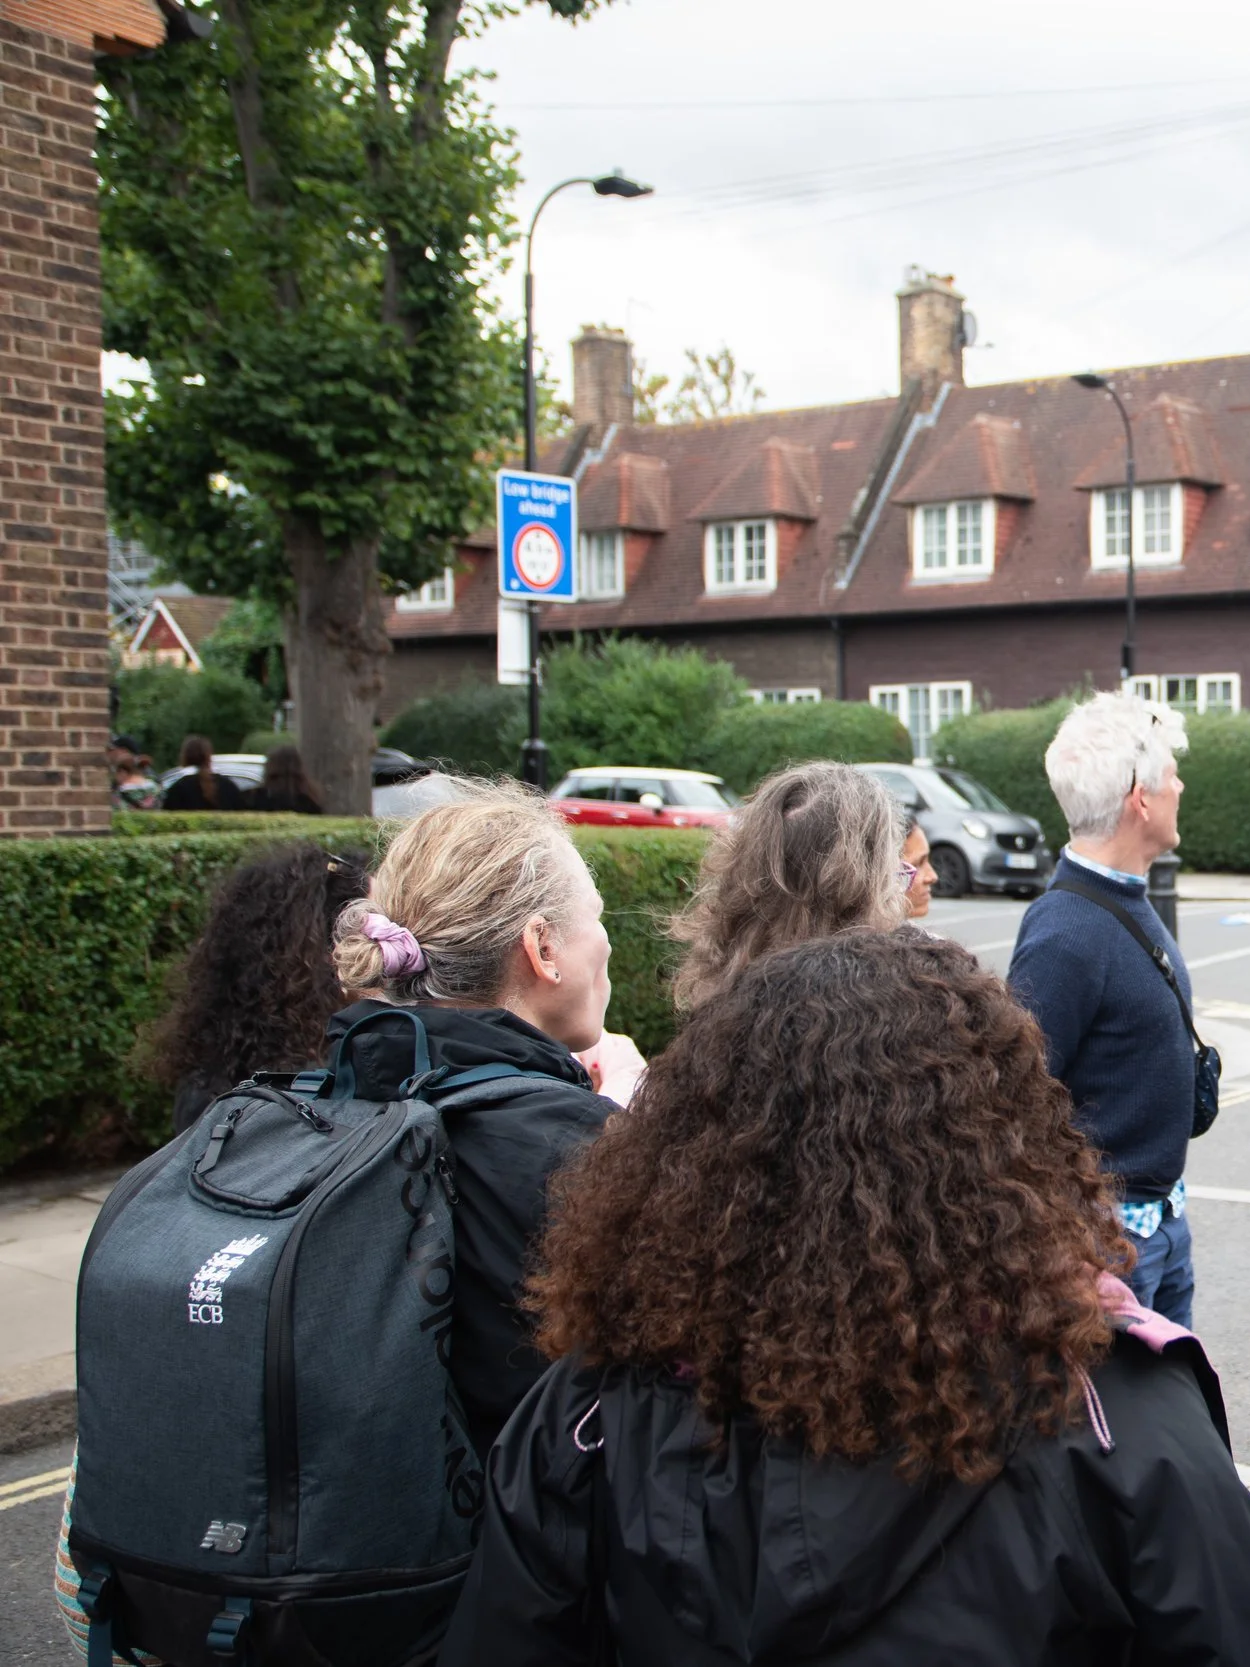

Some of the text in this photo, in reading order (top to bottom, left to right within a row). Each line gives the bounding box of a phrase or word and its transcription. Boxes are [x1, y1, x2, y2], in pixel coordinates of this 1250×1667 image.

[503, 478, 570, 505] Low bridge
[518, 498, 557, 519] ahead
[187, 1303, 224, 1324] ECB
